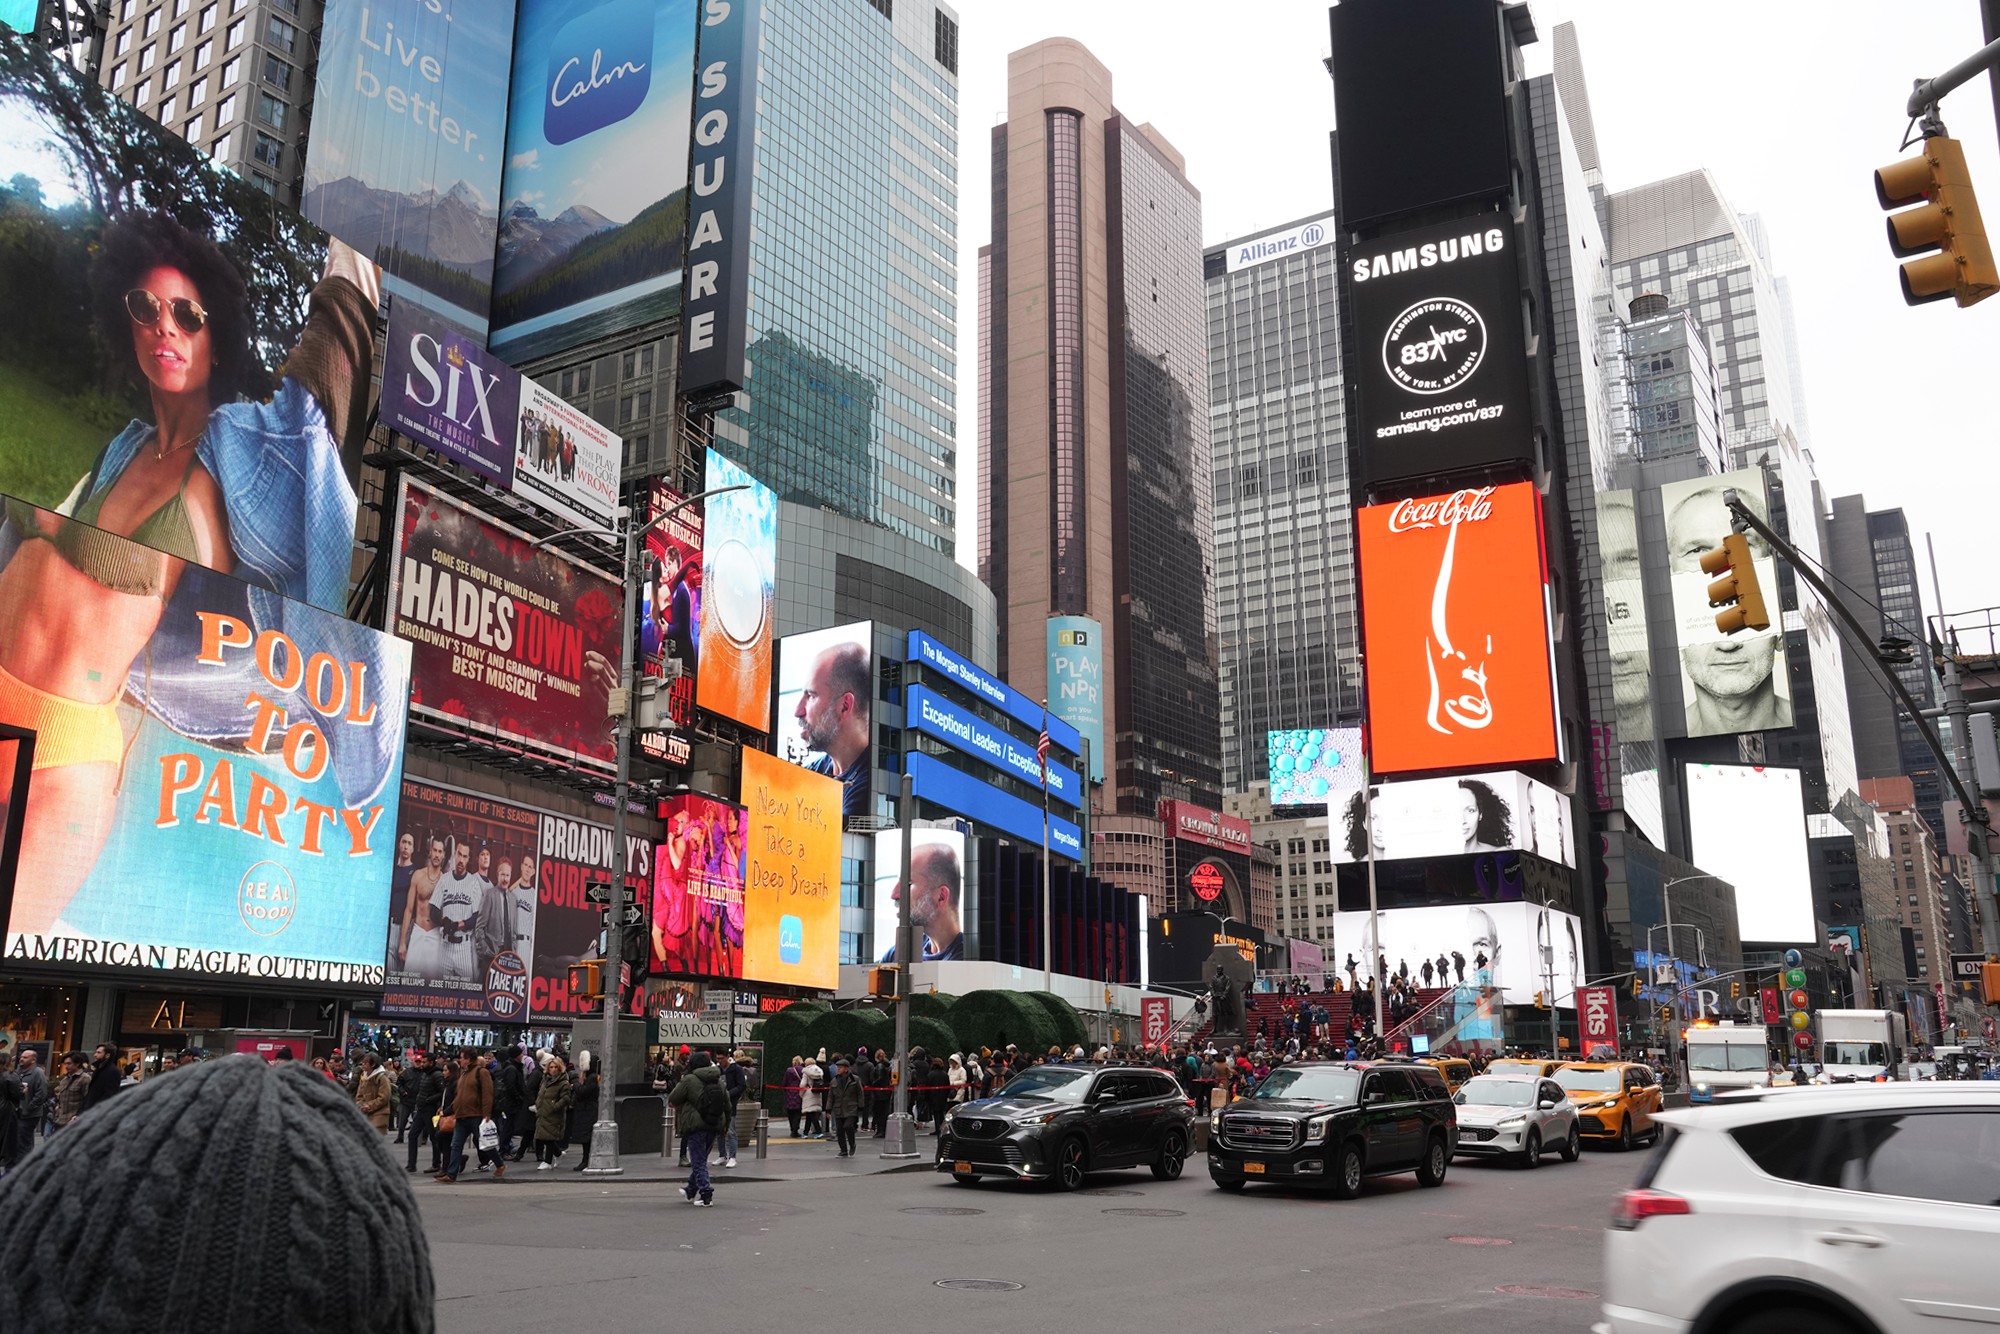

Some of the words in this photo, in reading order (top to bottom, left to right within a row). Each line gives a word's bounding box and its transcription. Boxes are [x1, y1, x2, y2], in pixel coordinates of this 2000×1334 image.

[359, 8, 443, 84] Live
[551, 48, 646, 108] Calm
[354, 54, 486, 161] better.
[689, 60, 728, 353] SQUARE
[1238, 235, 1298, 265] Allianz
[1353, 228, 1504, 282] SAMSUNG
[1390, 303, 1443, 341] WASHINGTON
[1444, 303, 1476, 325] STREET
[1401, 340, 1440, 365] 837
[1435, 328, 1467, 346] NYC
[405, 333, 501, 446] SIX
[1393, 365, 1412, 383] NEW
[1412, 378, 1441, 389] YORK,
[1443, 373, 1457, 385] NY
[533, 396, 543, 407] AND
[543, 402, 579, 430] INTERNATIONAL
[579, 426, 608, 448] PHENOMENON
[1376, 405, 1504, 438] samsung.com/837
[1400, 408, 1431, 421] Learn
[1432, 404, 1462, 417] more
[1463, 398, 1478, 411] at
[428, 413, 443, 432] THE
[446, 423, 480, 451] MUSICAL
[577, 454, 595, 472] THAT
[595, 465, 618, 488] GOES
[582, 446, 594, 460] THE
[595, 452, 615, 473] PLAY
[539, 482, 554, 496] WORLD
[555, 491, 571, 505] STAGES
[577, 466, 617, 504] WRONG
[431, 547, 455, 573] COME
[455, 559, 470, 575] SEE
[470, 563, 488, 582] HOW
[489, 572, 503, 589] THE
[503, 577, 528, 601] WORLD
[528, 589, 549, 611] COULD
[550, 601, 561, 616] BE.
[398, 620, 460, 653] BROADWAY'S
[487, 652, 505, 671] AND
[194, 611, 378, 727] POOL
[452, 655, 484, 681] BEST
[485, 665, 538, 702] MUSICAL
[922, 640, 935, 659] The
[935, 648, 959, 674] Morgan
[959, 662, 981, 690] Stanley
[981, 675, 1006, 703] Interview
[922, 698, 970, 741] Exceptional
[971, 726, 1002, 758] Leaders
[1067, 705, 1077, 713] on
[1079, 706, 1092, 715] your
[244, 690, 330, 784] TO
[641, 732, 667, 752] AARON
[668, 738, 691, 760] TVEIT
[154, 752, 385, 858] PARTY
[402, 782, 418, 798] THE
[419, 787, 464, 808] HOME-RUN
[465, 797, 478, 811] HIT
[479, 801, 489, 814] OF
[491, 804, 506, 818] THE
[507, 808, 538, 826] SEASON!
[756, 785, 789, 817] New
[796, 797, 827, 832] York,
[542, 815, 650, 876] BROADWY'S
[763, 825, 793, 856] Take
[799, 842, 805, 861] a
[1221, 826, 1248, 843] PLAZA
[246, 881, 290, 902] REAL
[540, 860, 591, 911] SURE
[593, 890, 608, 899] ONE
[687, 879, 701, 896] LIFE
[702, 883, 709, 898] IS
[752, 859, 785, 903] Deep
[790, 864, 829, 902] Breath
[780, 929, 801, 950] Calm
[9, 933, 166, 970] AMERICAN
[176, 947, 251, 977] EAGLE
[256, 954, 384, 986] OUTFITTERS
[385, 976, 400, 985] JESSE
[401, 977, 425, 987] WILLIAMS
[429, 980, 444, 989] JESSE
[444, 981, 459, 989] TYLER
[459, 983, 483, 992] FERGUSON
[489, 968, 511, 991] TAKE
[512, 975, 527, 998] ME
[383, 992, 418, 1006] THROUGH
[420, 995, 458, 1008] FEBRUARY
[466, 998, 485, 1010] ONLY
[494, 995, 515, 1014] OUT
[762, 997, 775, 1012] DOS
[1586, 991, 1609, 1036] tkts
[445, 1027, 494, 1046] GRAND
[660, 1023, 742, 1038] SWAROVSKI
[1148, 1001, 1165, 1040] tkts
